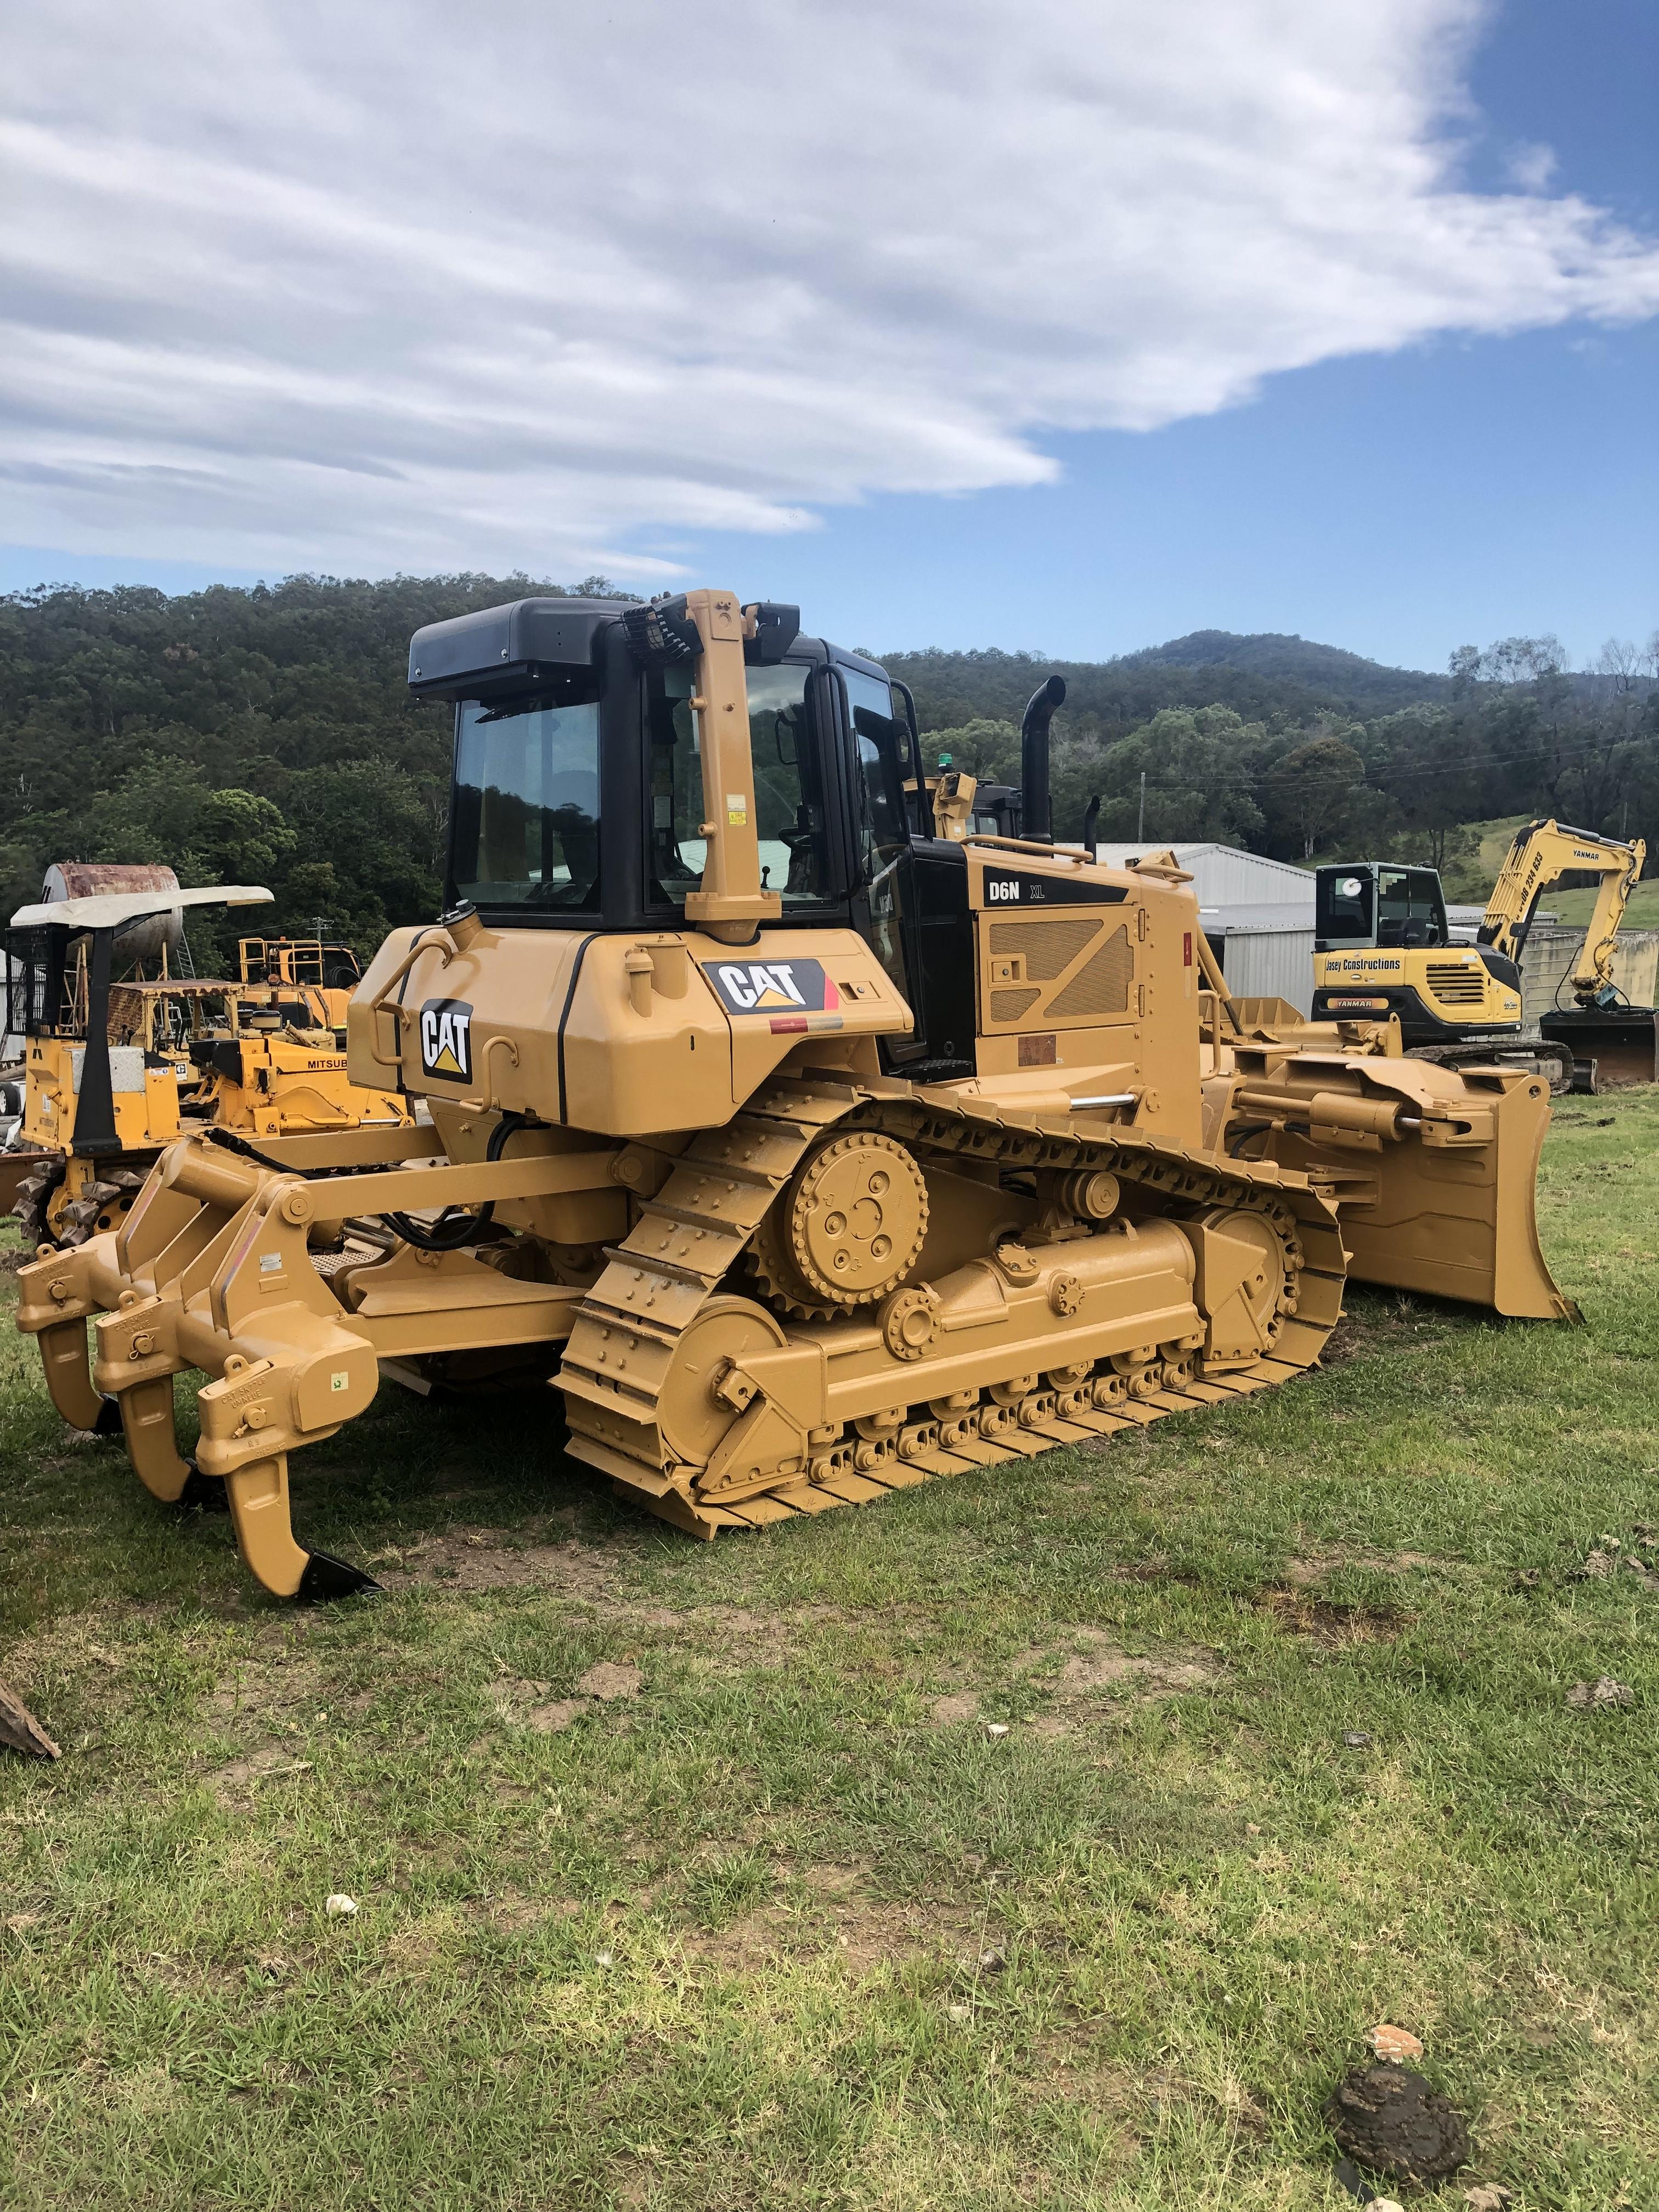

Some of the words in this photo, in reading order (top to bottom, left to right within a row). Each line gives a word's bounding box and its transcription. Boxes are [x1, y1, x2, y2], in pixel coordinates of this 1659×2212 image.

[1573, 850, 1599, 860] YANMAR
[1525, 869, 1536, 889] 234
[1532, 851, 1543, 872] 633
[989, 881, 1020, 900] D6N
[1030, 885, 1045, 899] XL
[1343, 958, 1401, 970] Constructions
[718, 965, 807, 1008] CAT
[422, 1010, 470, 1074] CAT
[221, 1391, 236, 1404] CAT
